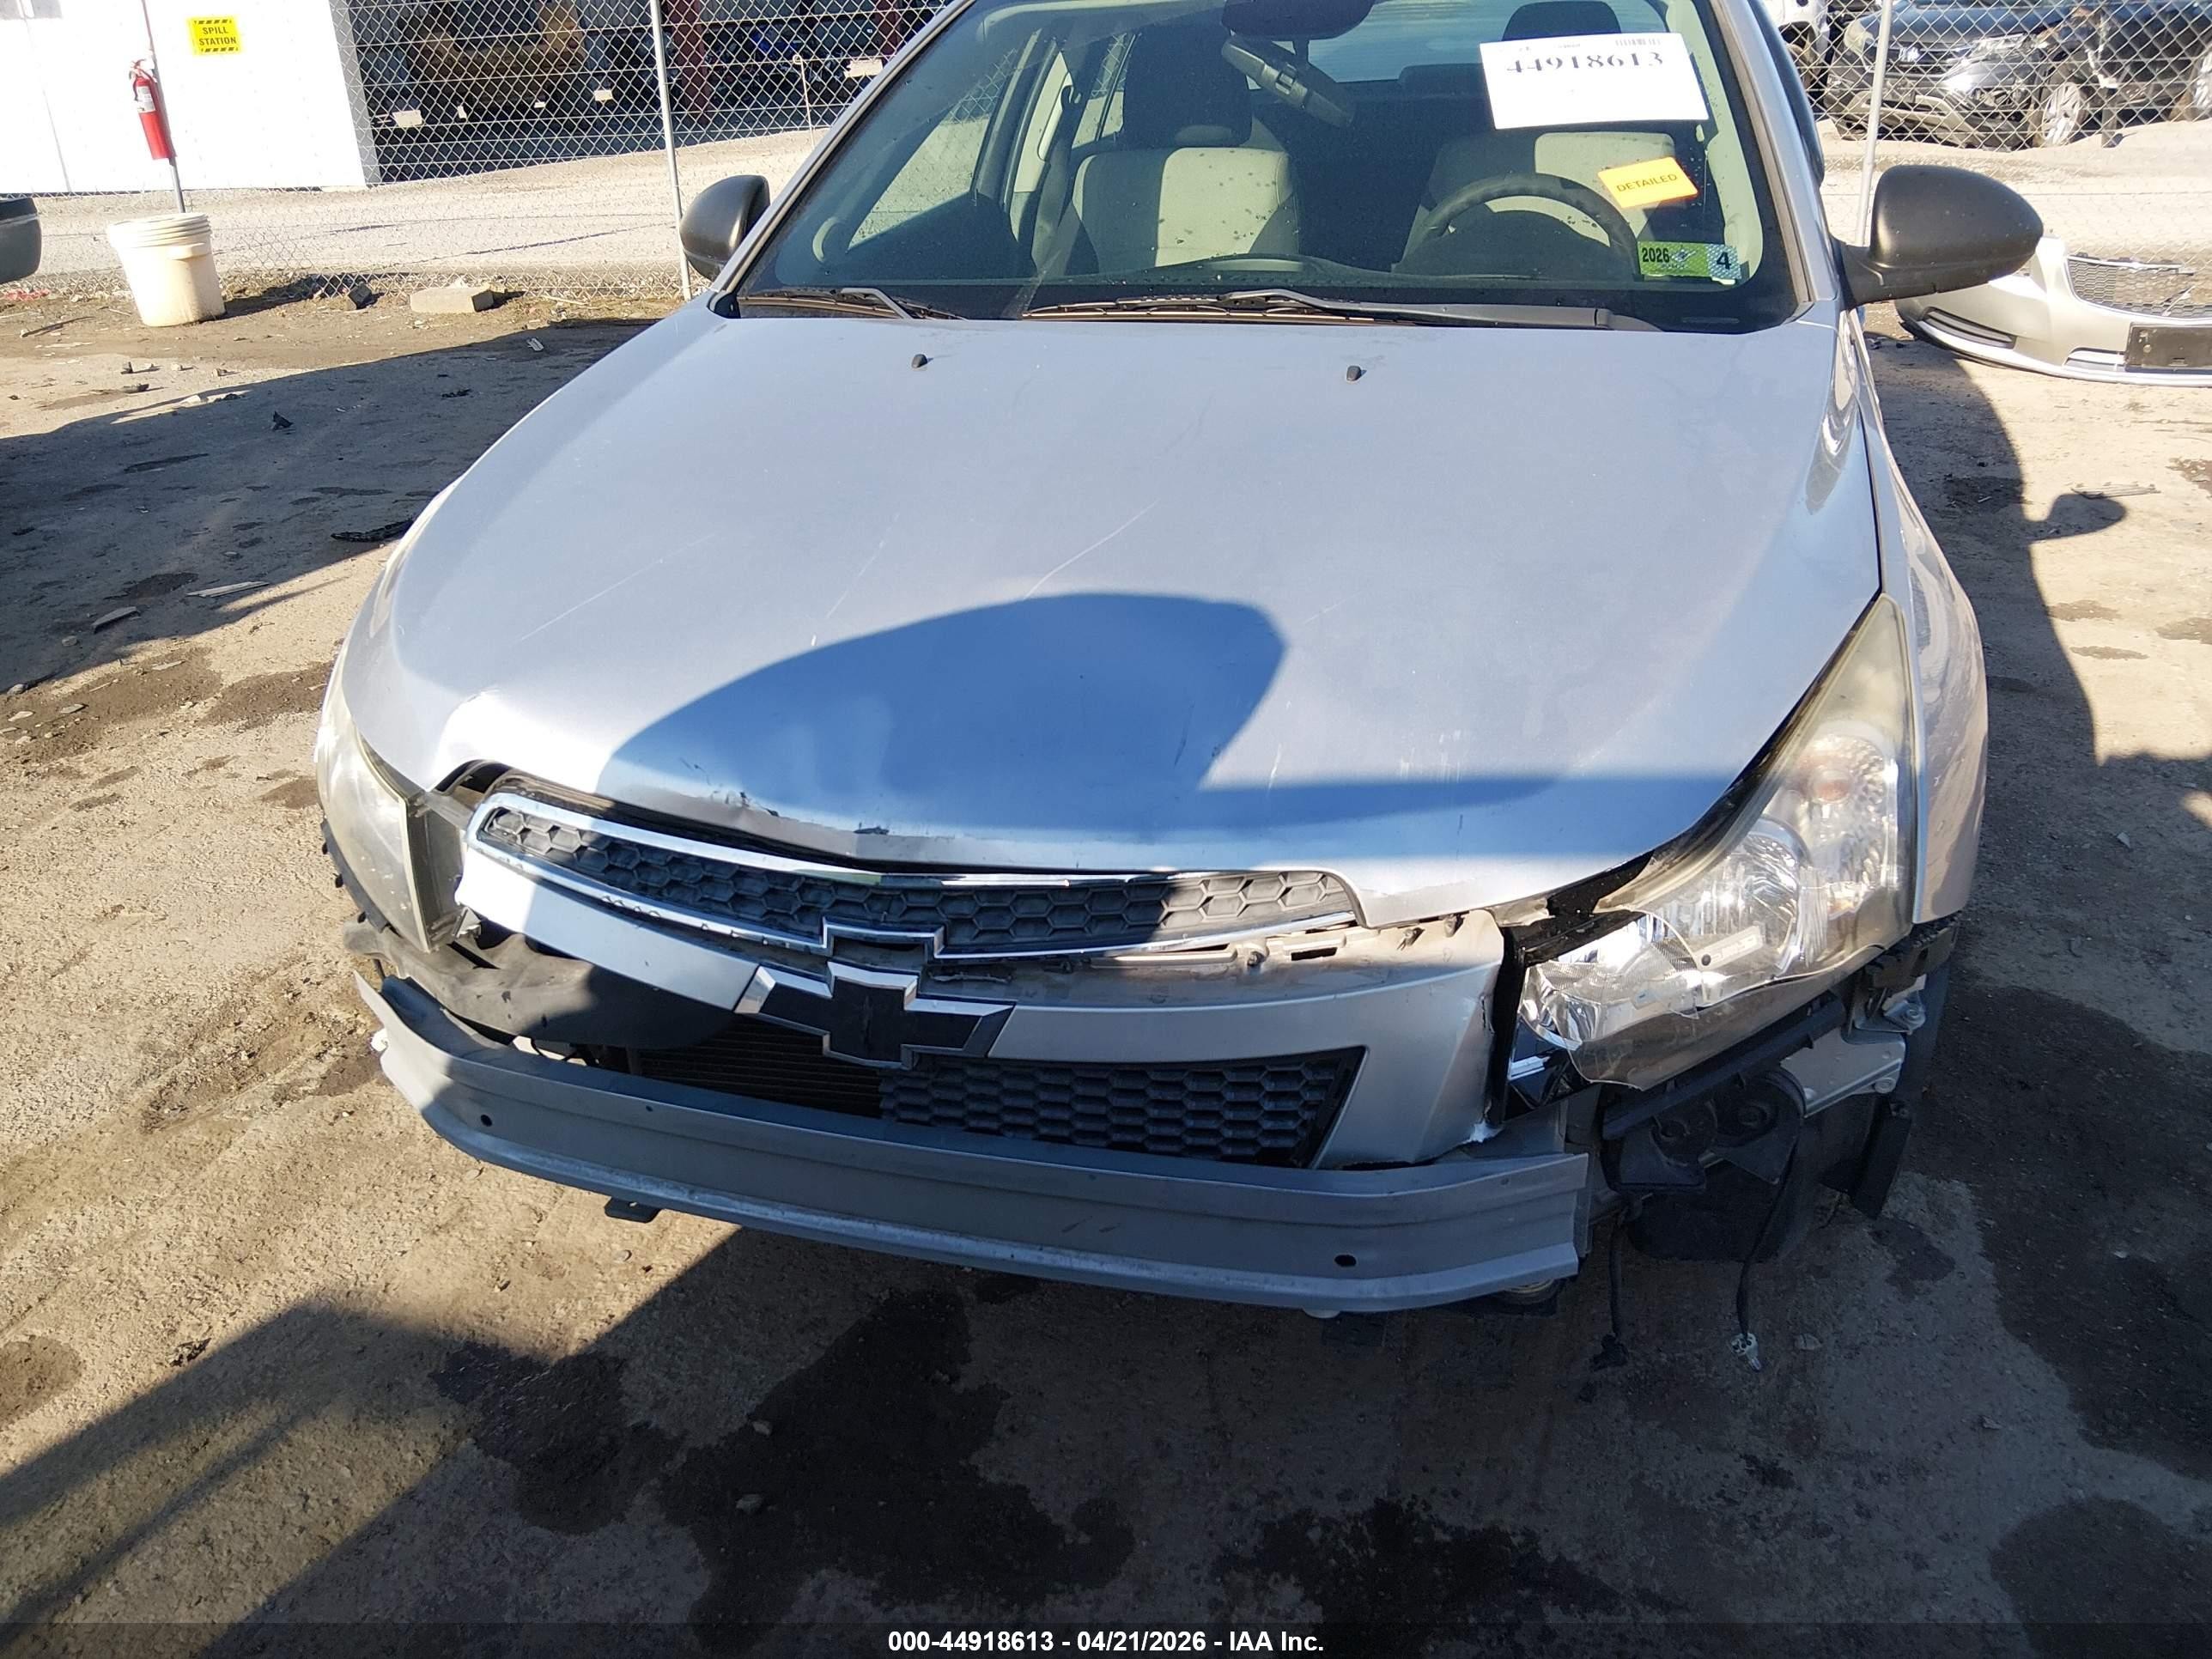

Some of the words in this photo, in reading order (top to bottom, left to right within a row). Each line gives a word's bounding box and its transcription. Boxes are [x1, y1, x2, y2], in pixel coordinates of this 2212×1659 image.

[202, 27, 229, 35] SPILL
[198, 37, 237, 46] STATION
[1506, 52, 1663, 73] 44918613
[1616, 173, 1678, 192] DETAILED
[1641, 246, 1670, 263] 2026
[1717, 252, 1732, 270] 4
